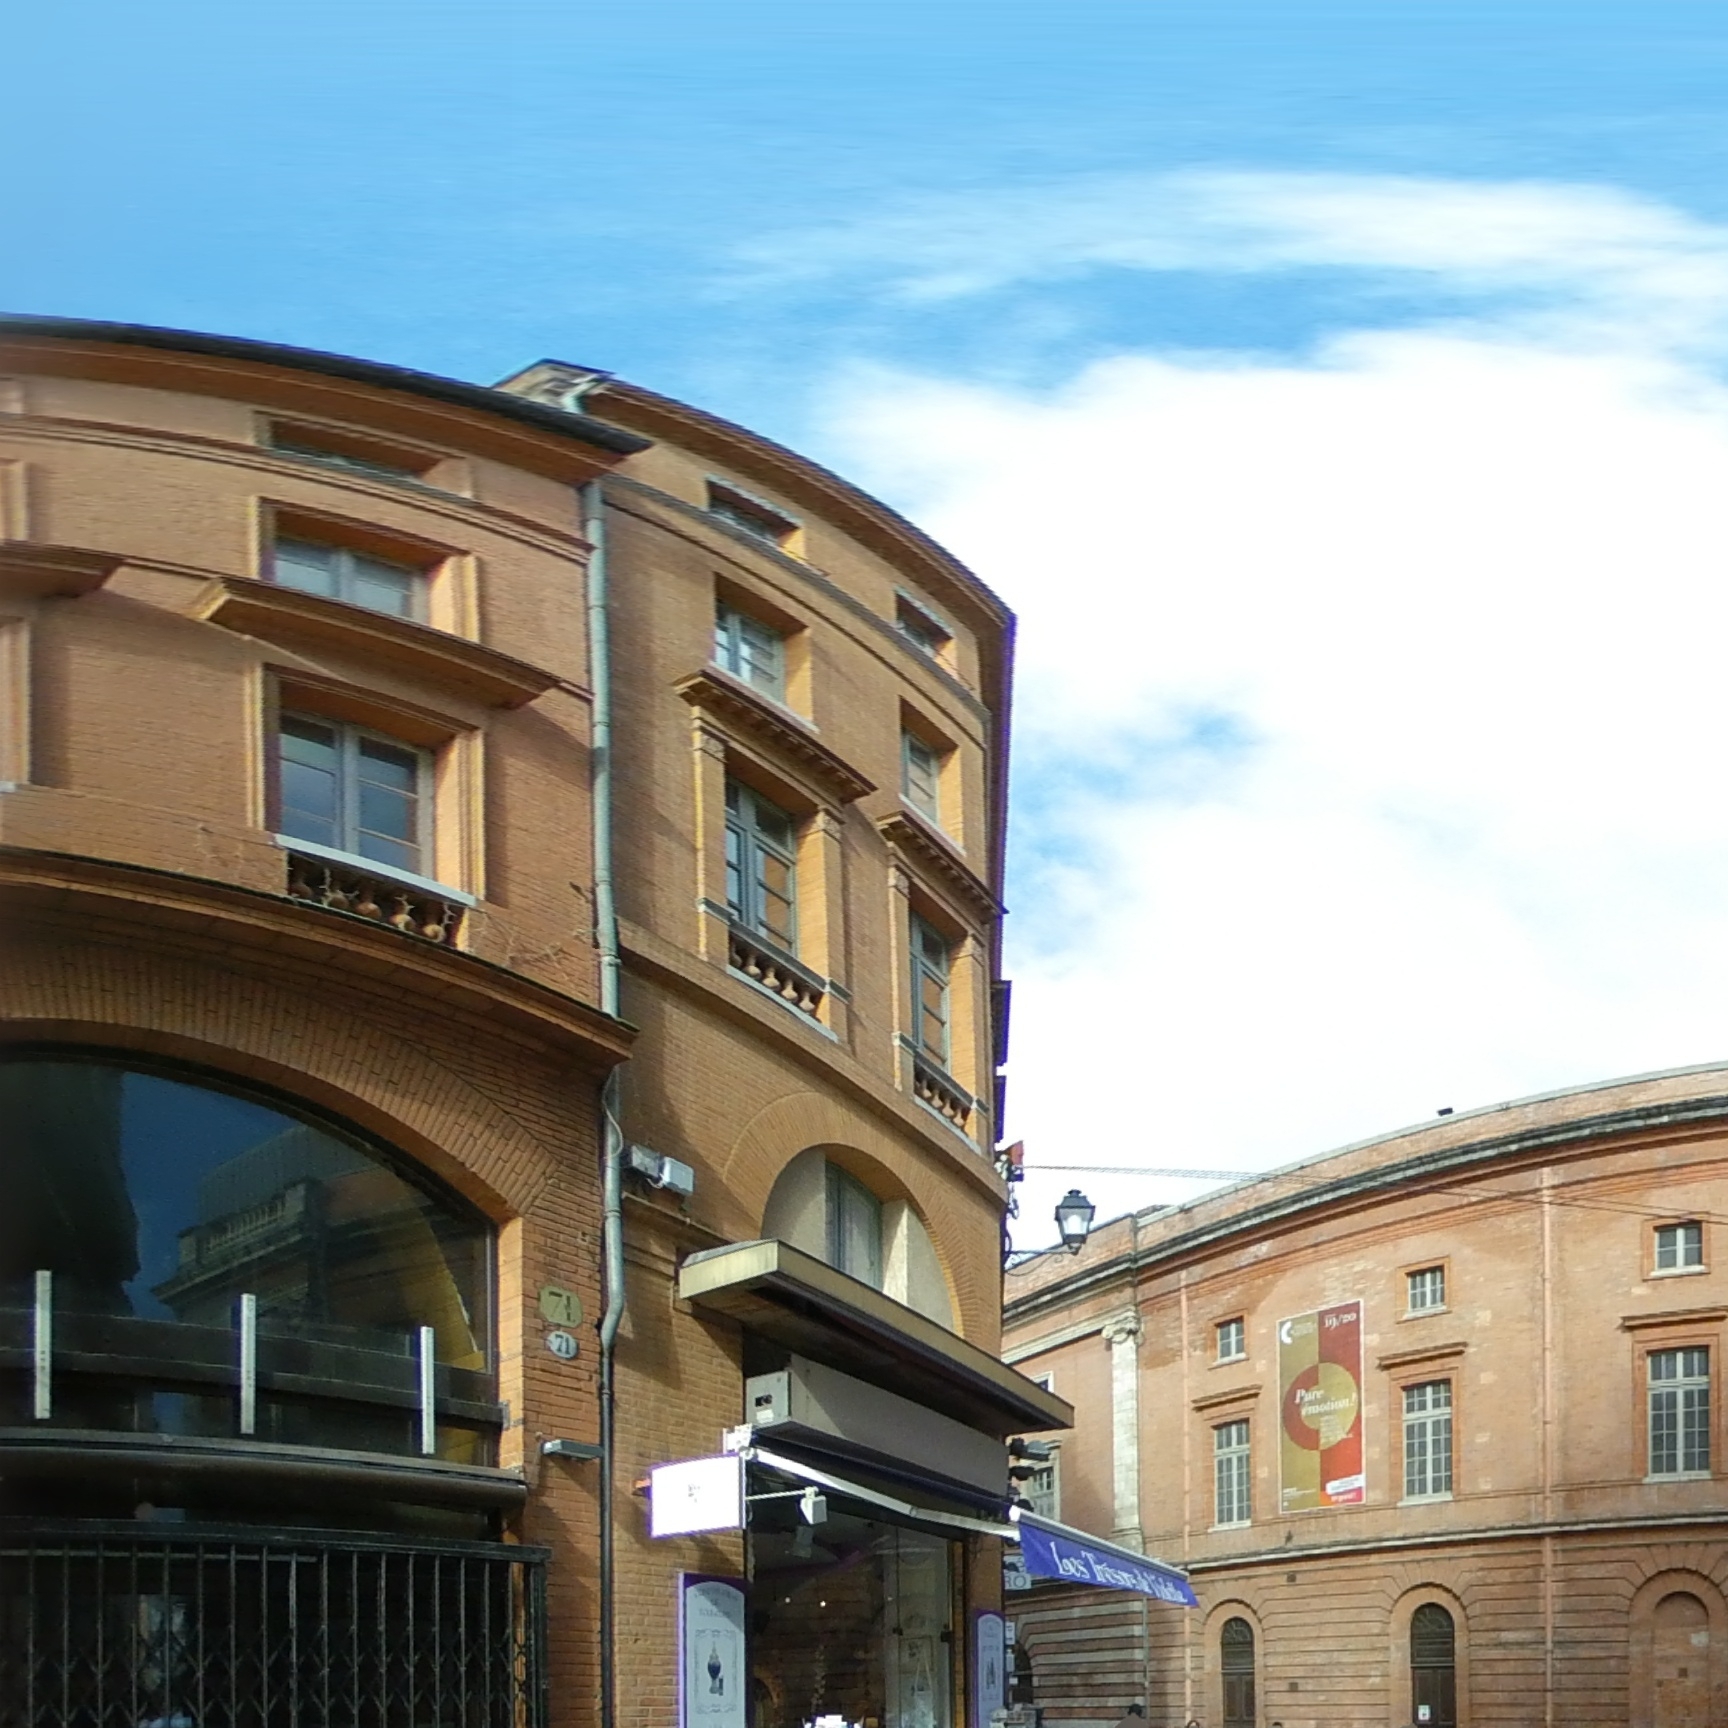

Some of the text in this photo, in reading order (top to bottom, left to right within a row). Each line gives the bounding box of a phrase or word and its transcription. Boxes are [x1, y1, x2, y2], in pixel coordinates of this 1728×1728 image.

[554, 1333, 572, 1356] 71
[1294, 1388, 1325, 1405] Pure
[1050, 1541, 1090, 1578] Les
